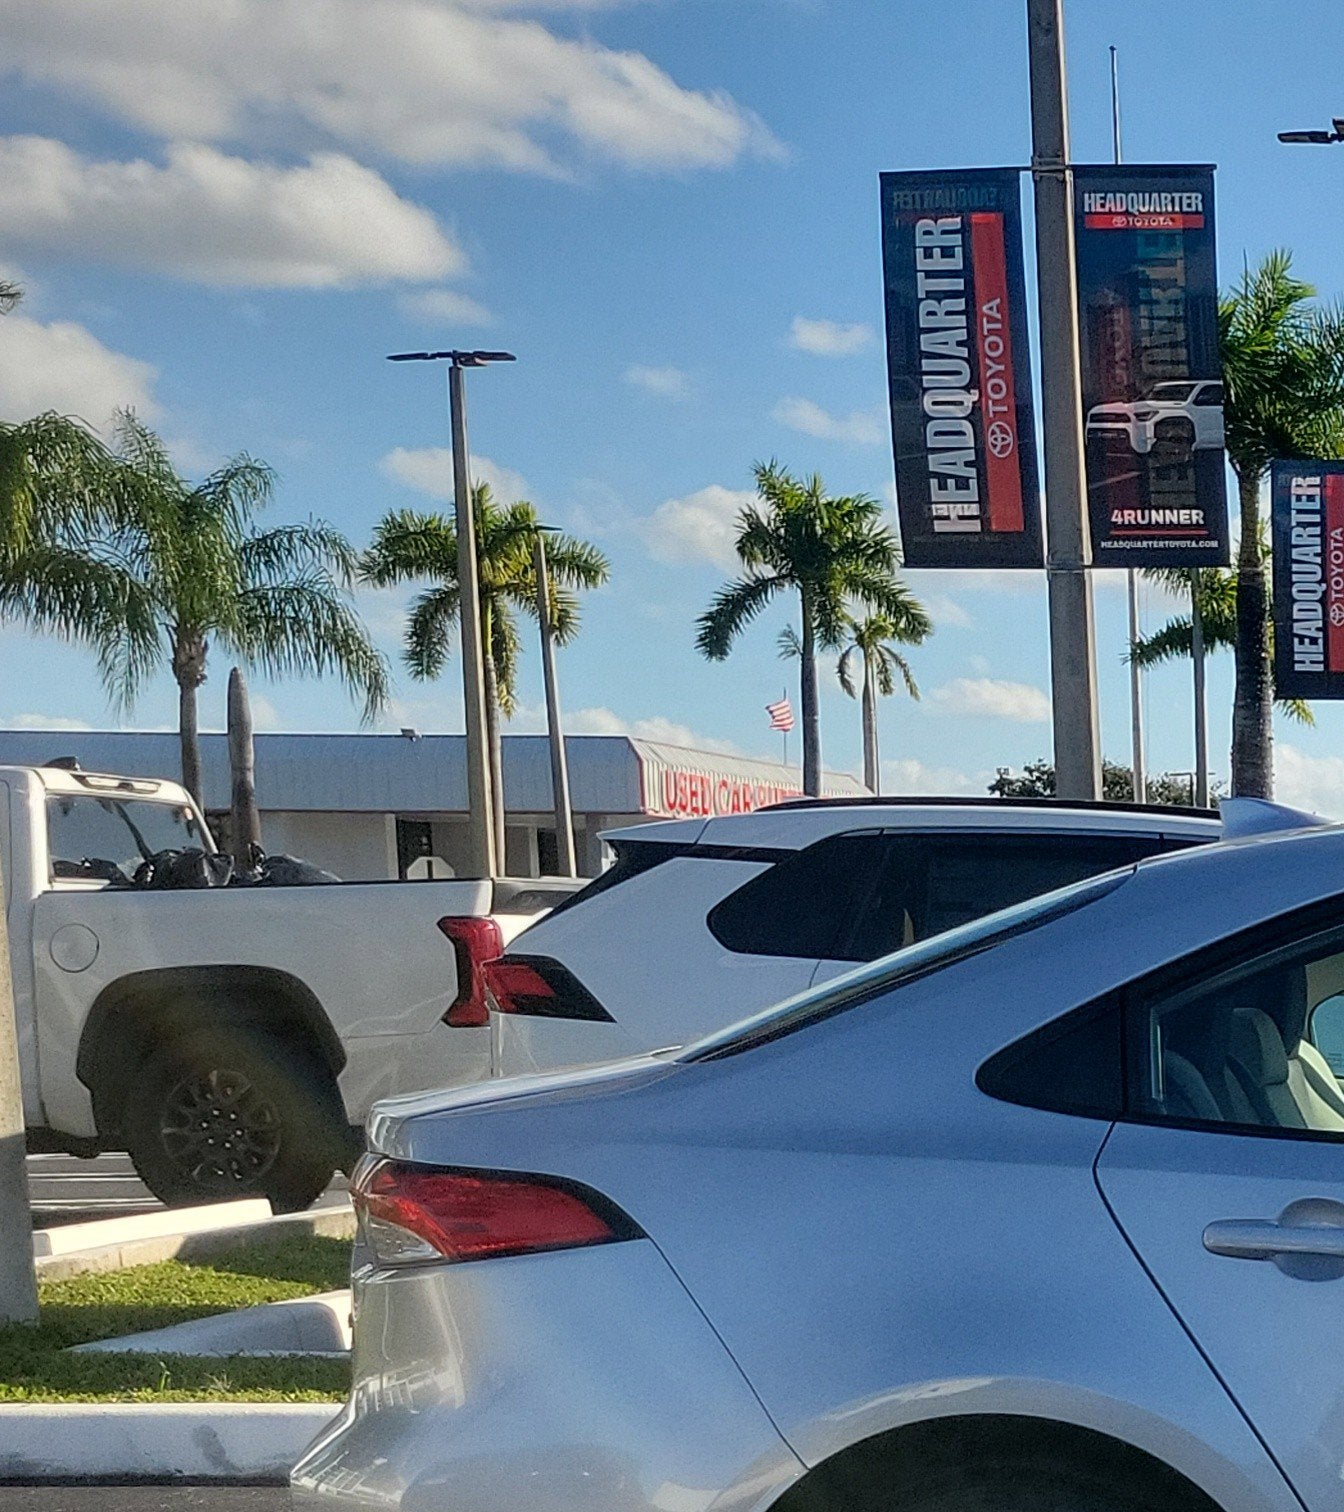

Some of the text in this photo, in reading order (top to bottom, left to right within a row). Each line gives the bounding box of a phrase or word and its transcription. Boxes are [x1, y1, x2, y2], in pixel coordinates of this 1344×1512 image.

[1084, 192, 1203, 215] HEADQUARTER
[1128, 216, 1173, 226] TOYOTA
[915, 214, 982, 533] HEADQUARTER
[981, 298, 1009, 418] TOYOTA
[1110, 509, 1204, 525] 4RUNNER
[1291, 476, 1326, 672] HEADQUARTER
[664, 770, 711, 815] USED
[715, 778, 753, 815] CAR
